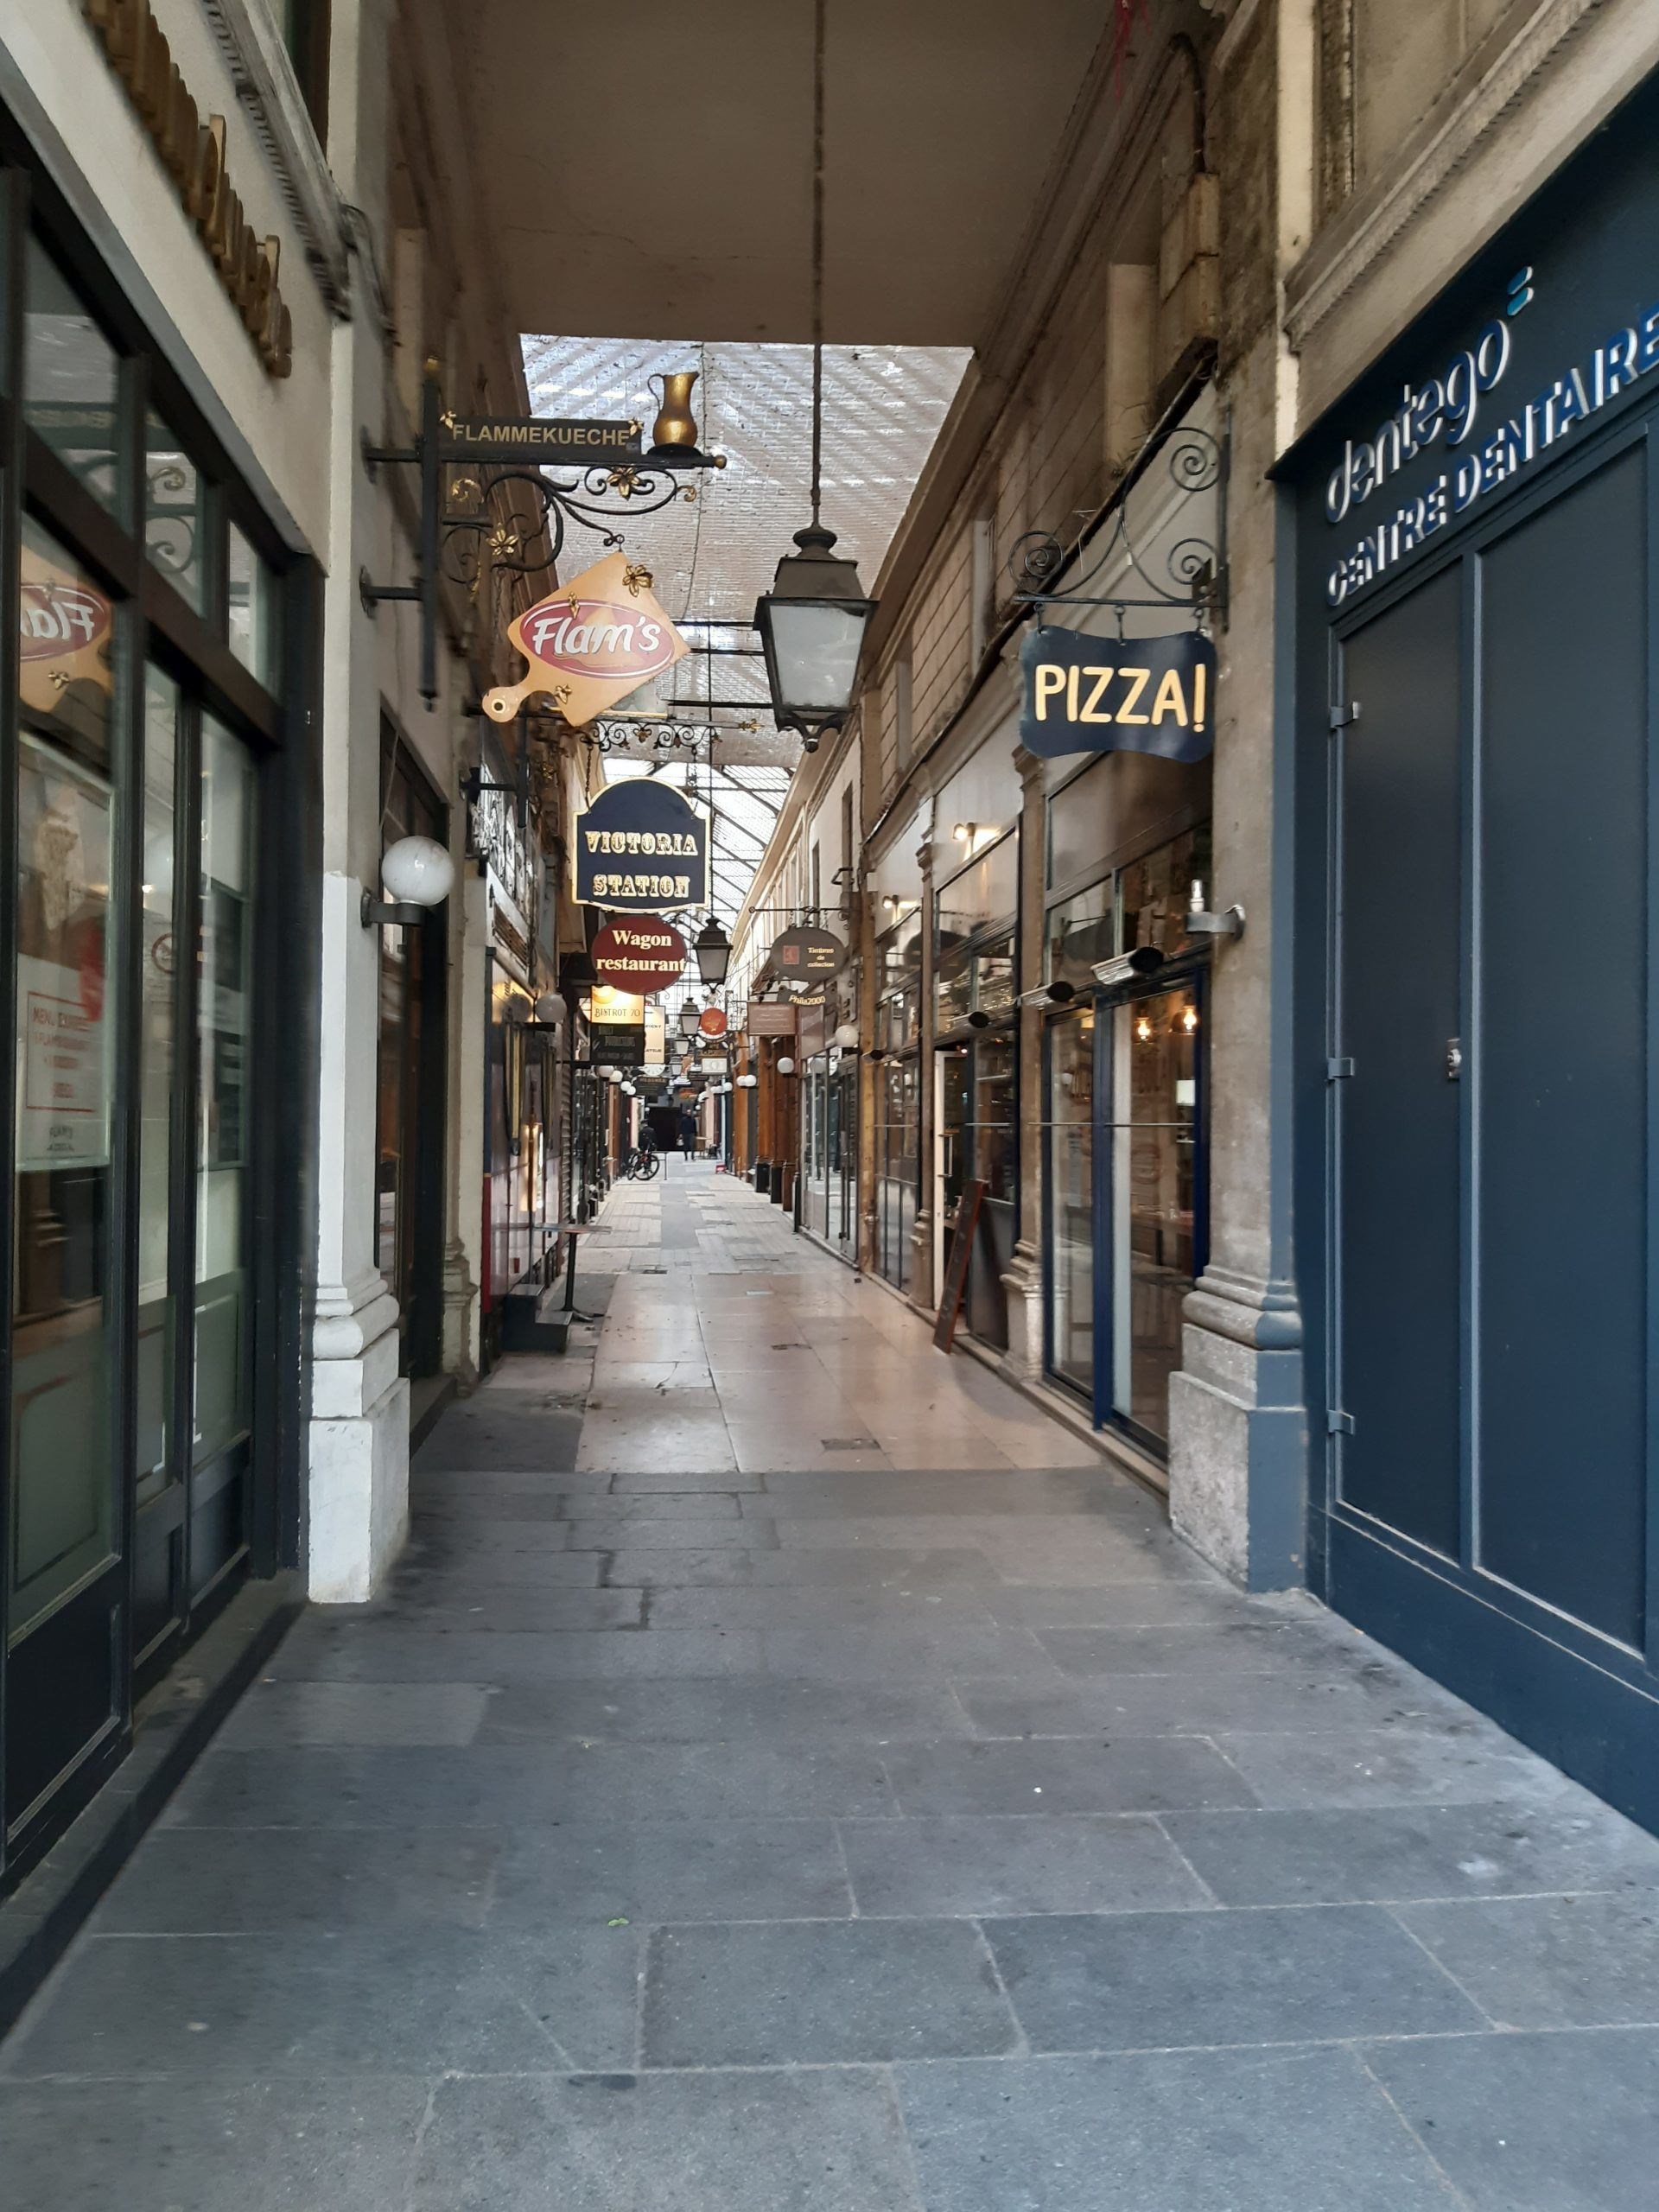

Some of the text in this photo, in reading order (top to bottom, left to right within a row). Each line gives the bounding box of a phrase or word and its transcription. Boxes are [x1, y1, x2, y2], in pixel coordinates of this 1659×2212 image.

[1326, 318, 1510, 524] dentego
[451, 423, 631, 446] FLAMMEKUECHE
[1327, 301, 1659, 607] CENTRE DENTAIRE
[532, 615, 661, 656] Flam's
[1035, 664, 1206, 733] PIZZA!
[585, 830, 698, 856] VICTORIA
[593, 874, 690, 898] STATION
[612, 930, 672, 950] Wagon
[596, 957, 686, 972] restaurant
[788, 994, 826, 1005] Phila2000
[594, 1008, 641, 1018] BISTROT 70
